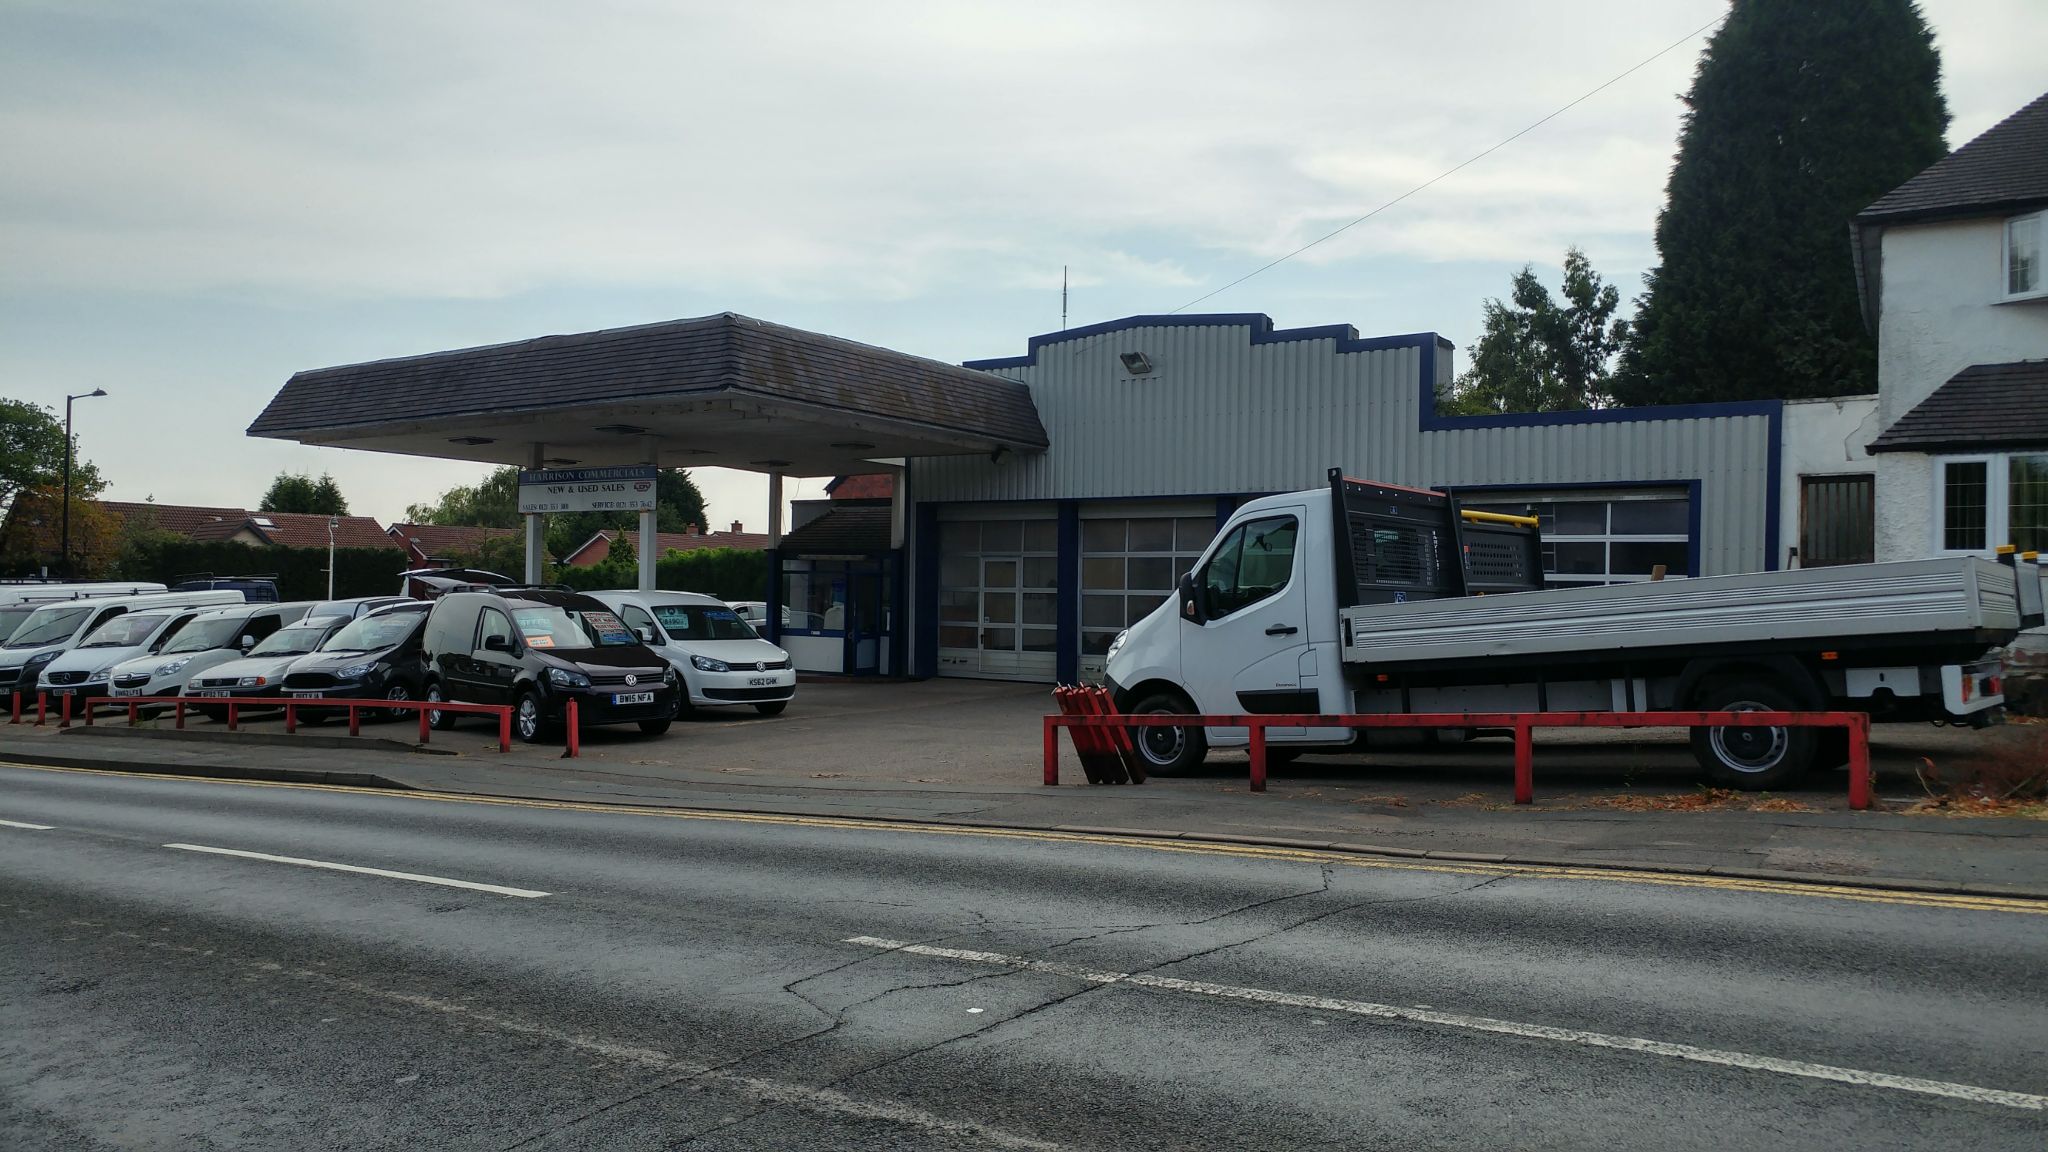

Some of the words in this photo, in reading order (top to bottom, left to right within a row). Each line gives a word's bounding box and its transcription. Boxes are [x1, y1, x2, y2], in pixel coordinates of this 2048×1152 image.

[529, 471, 575, 482] HARRISON
[578, 468, 646, 480] COMMERCIALS
[547, 486, 566, 494] NEW
[568, 486, 575, 494] &
[578, 485, 599, 493] USED
[602, 483, 626, 492] SALES
[619, 695, 636, 703] BW15
[637, 693, 651, 702] NFA
